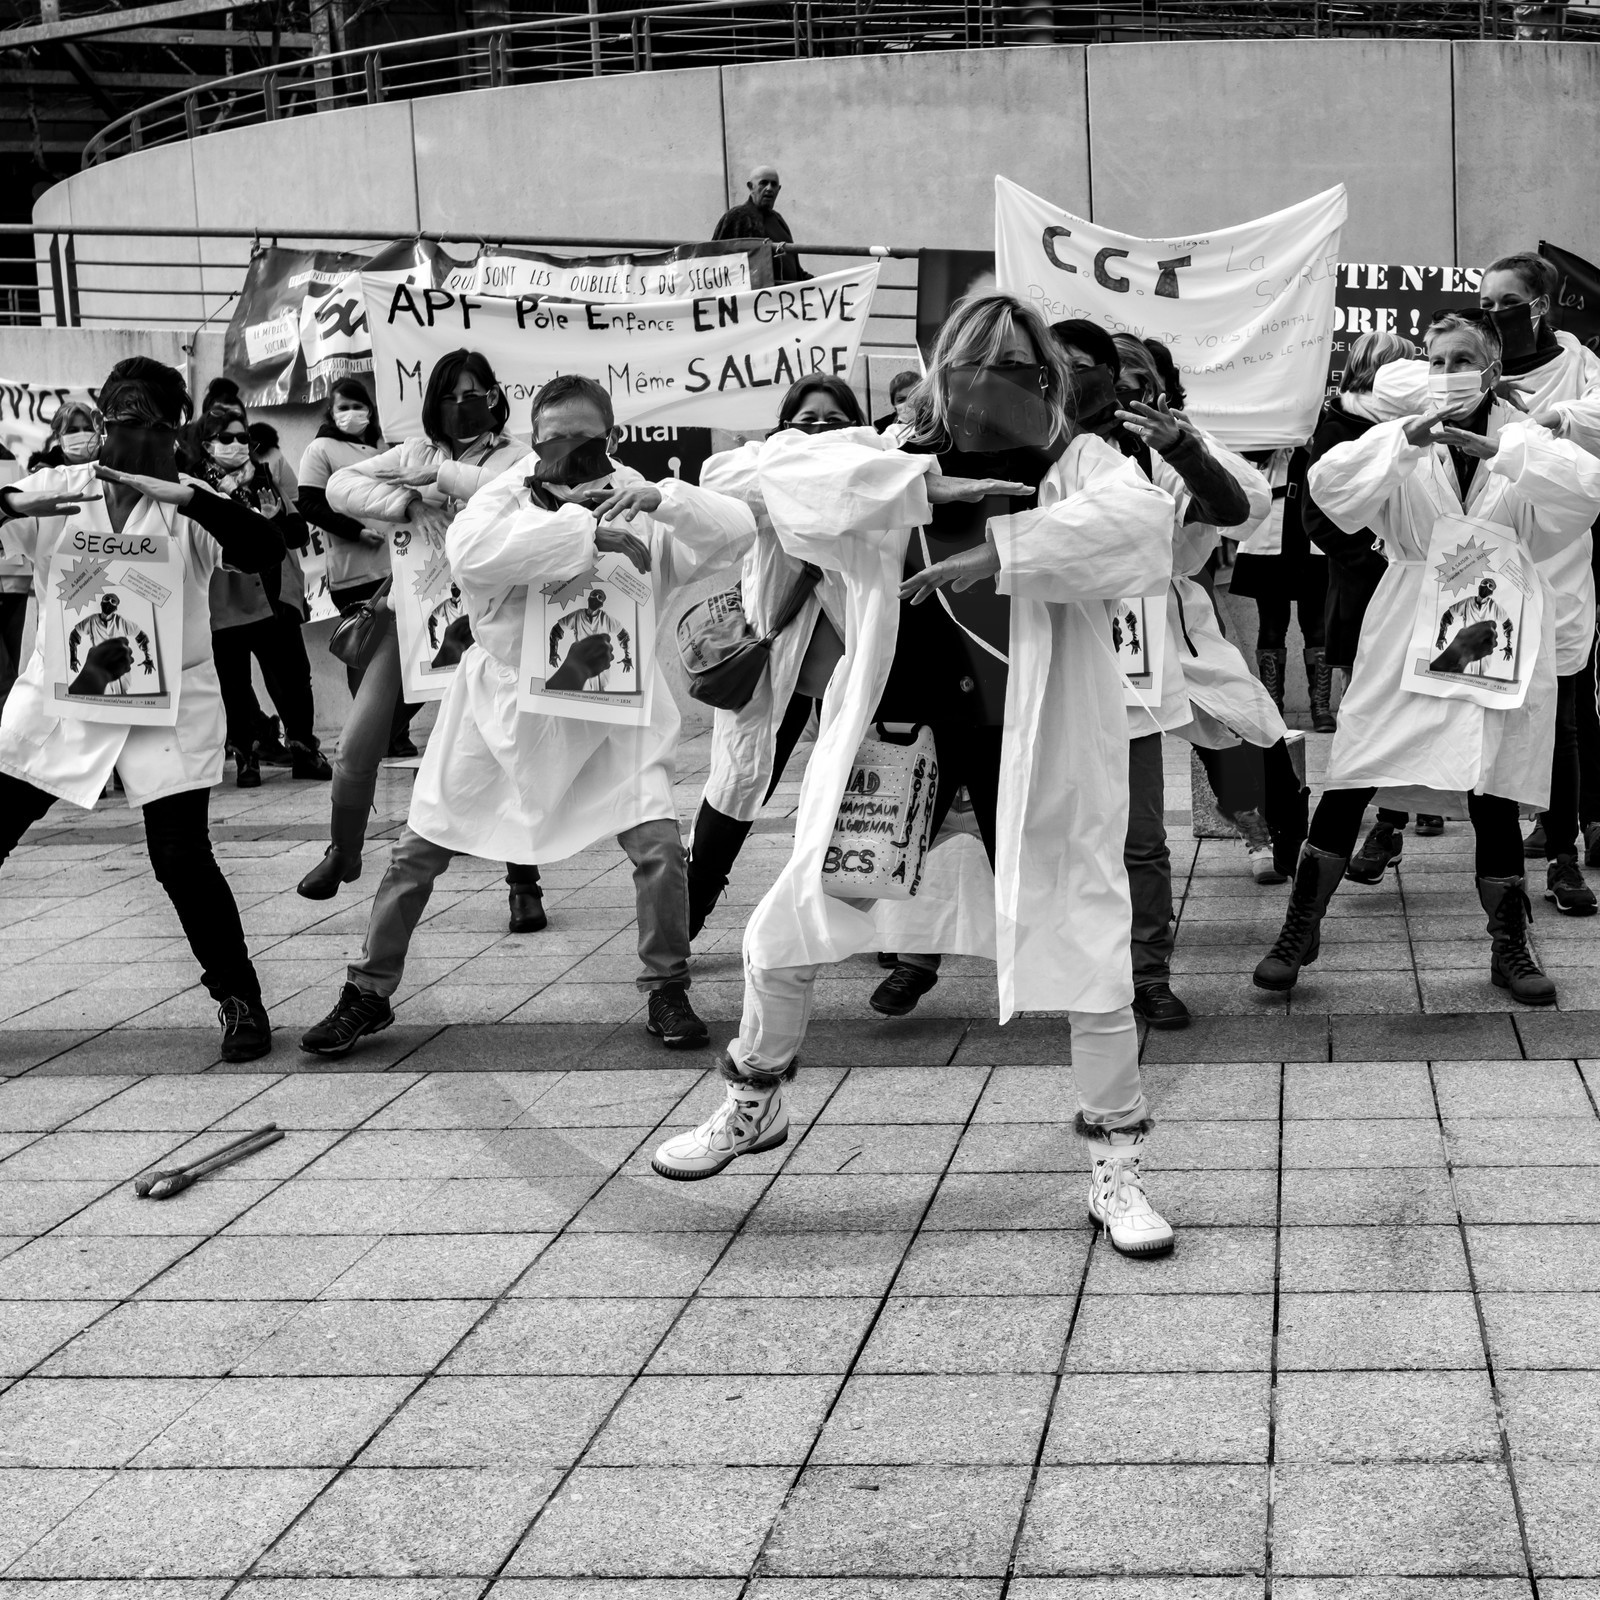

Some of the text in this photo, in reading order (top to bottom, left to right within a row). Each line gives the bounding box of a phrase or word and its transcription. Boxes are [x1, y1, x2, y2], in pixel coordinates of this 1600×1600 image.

[483, 265, 517, 287] SONT
[530, 268, 552, 287] LES
[658, 274, 676, 295] DU
[688, 265, 732, 292] SEGUR
[1335, 263, 1389, 290] TE
[387, 283, 482, 330] APF
[515, 300, 569, 331] Pôle
[692, 295, 739, 332] EN
[753, 283, 860, 323] GREVE
[1409, 308, 1421, 336] !
[1243, 351, 1274, 365] PLUS
[607, 362, 676, 398] Même
[72, 531, 158, 556] SEGUR
[396, 547, 409, 556] cgt
[822, 846, 876, 874] BCS
